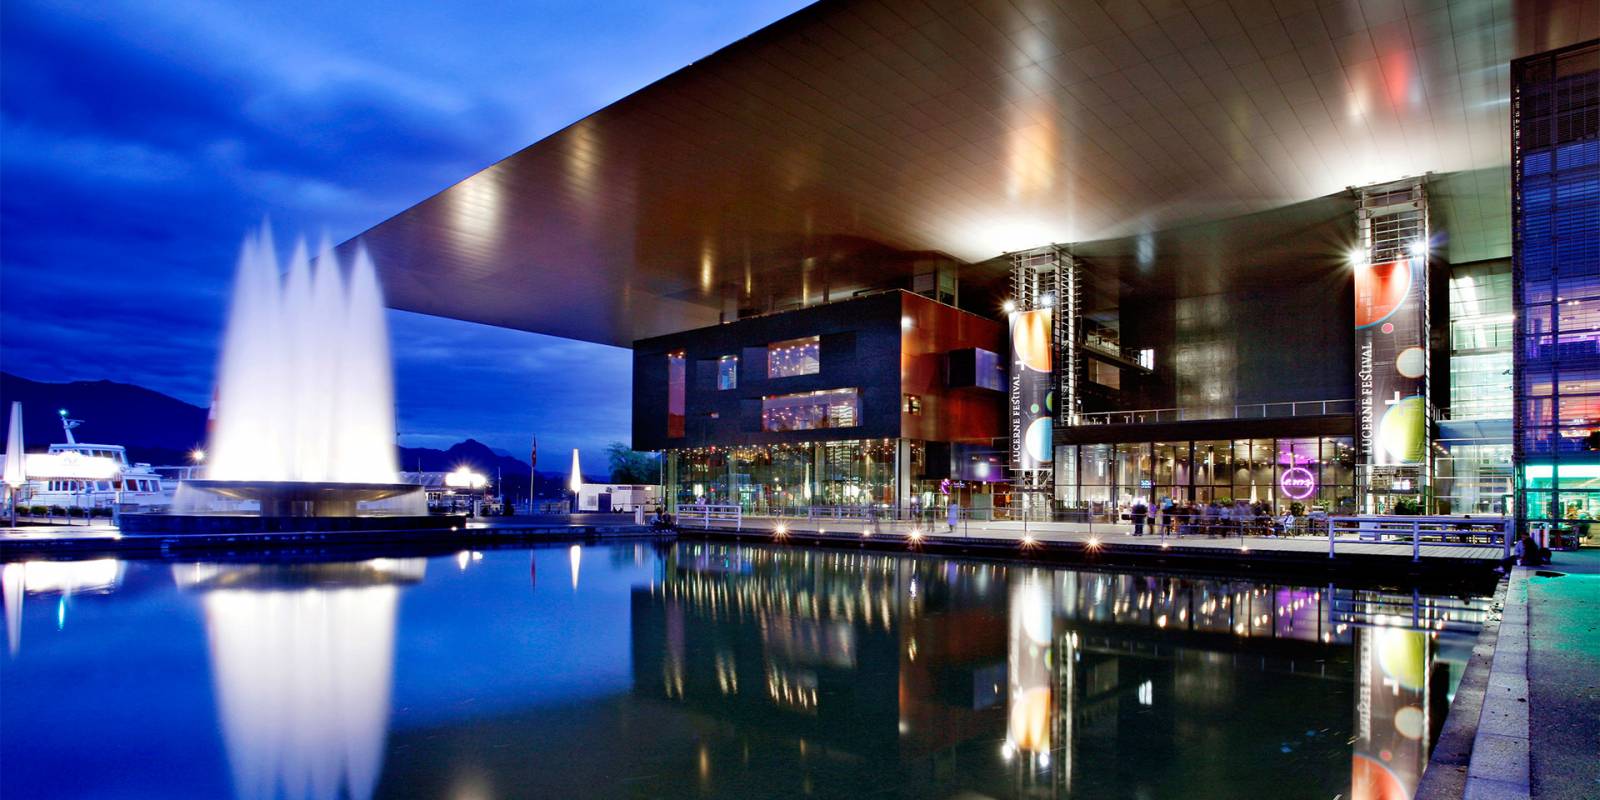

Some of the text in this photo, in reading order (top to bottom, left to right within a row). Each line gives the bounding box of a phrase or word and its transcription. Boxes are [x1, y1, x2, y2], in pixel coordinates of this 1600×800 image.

[1012, 374, 1021, 462] LUCERNE FESTIVAL
[1359, 342, 1373, 453] LUCERNE FESTIVAL
